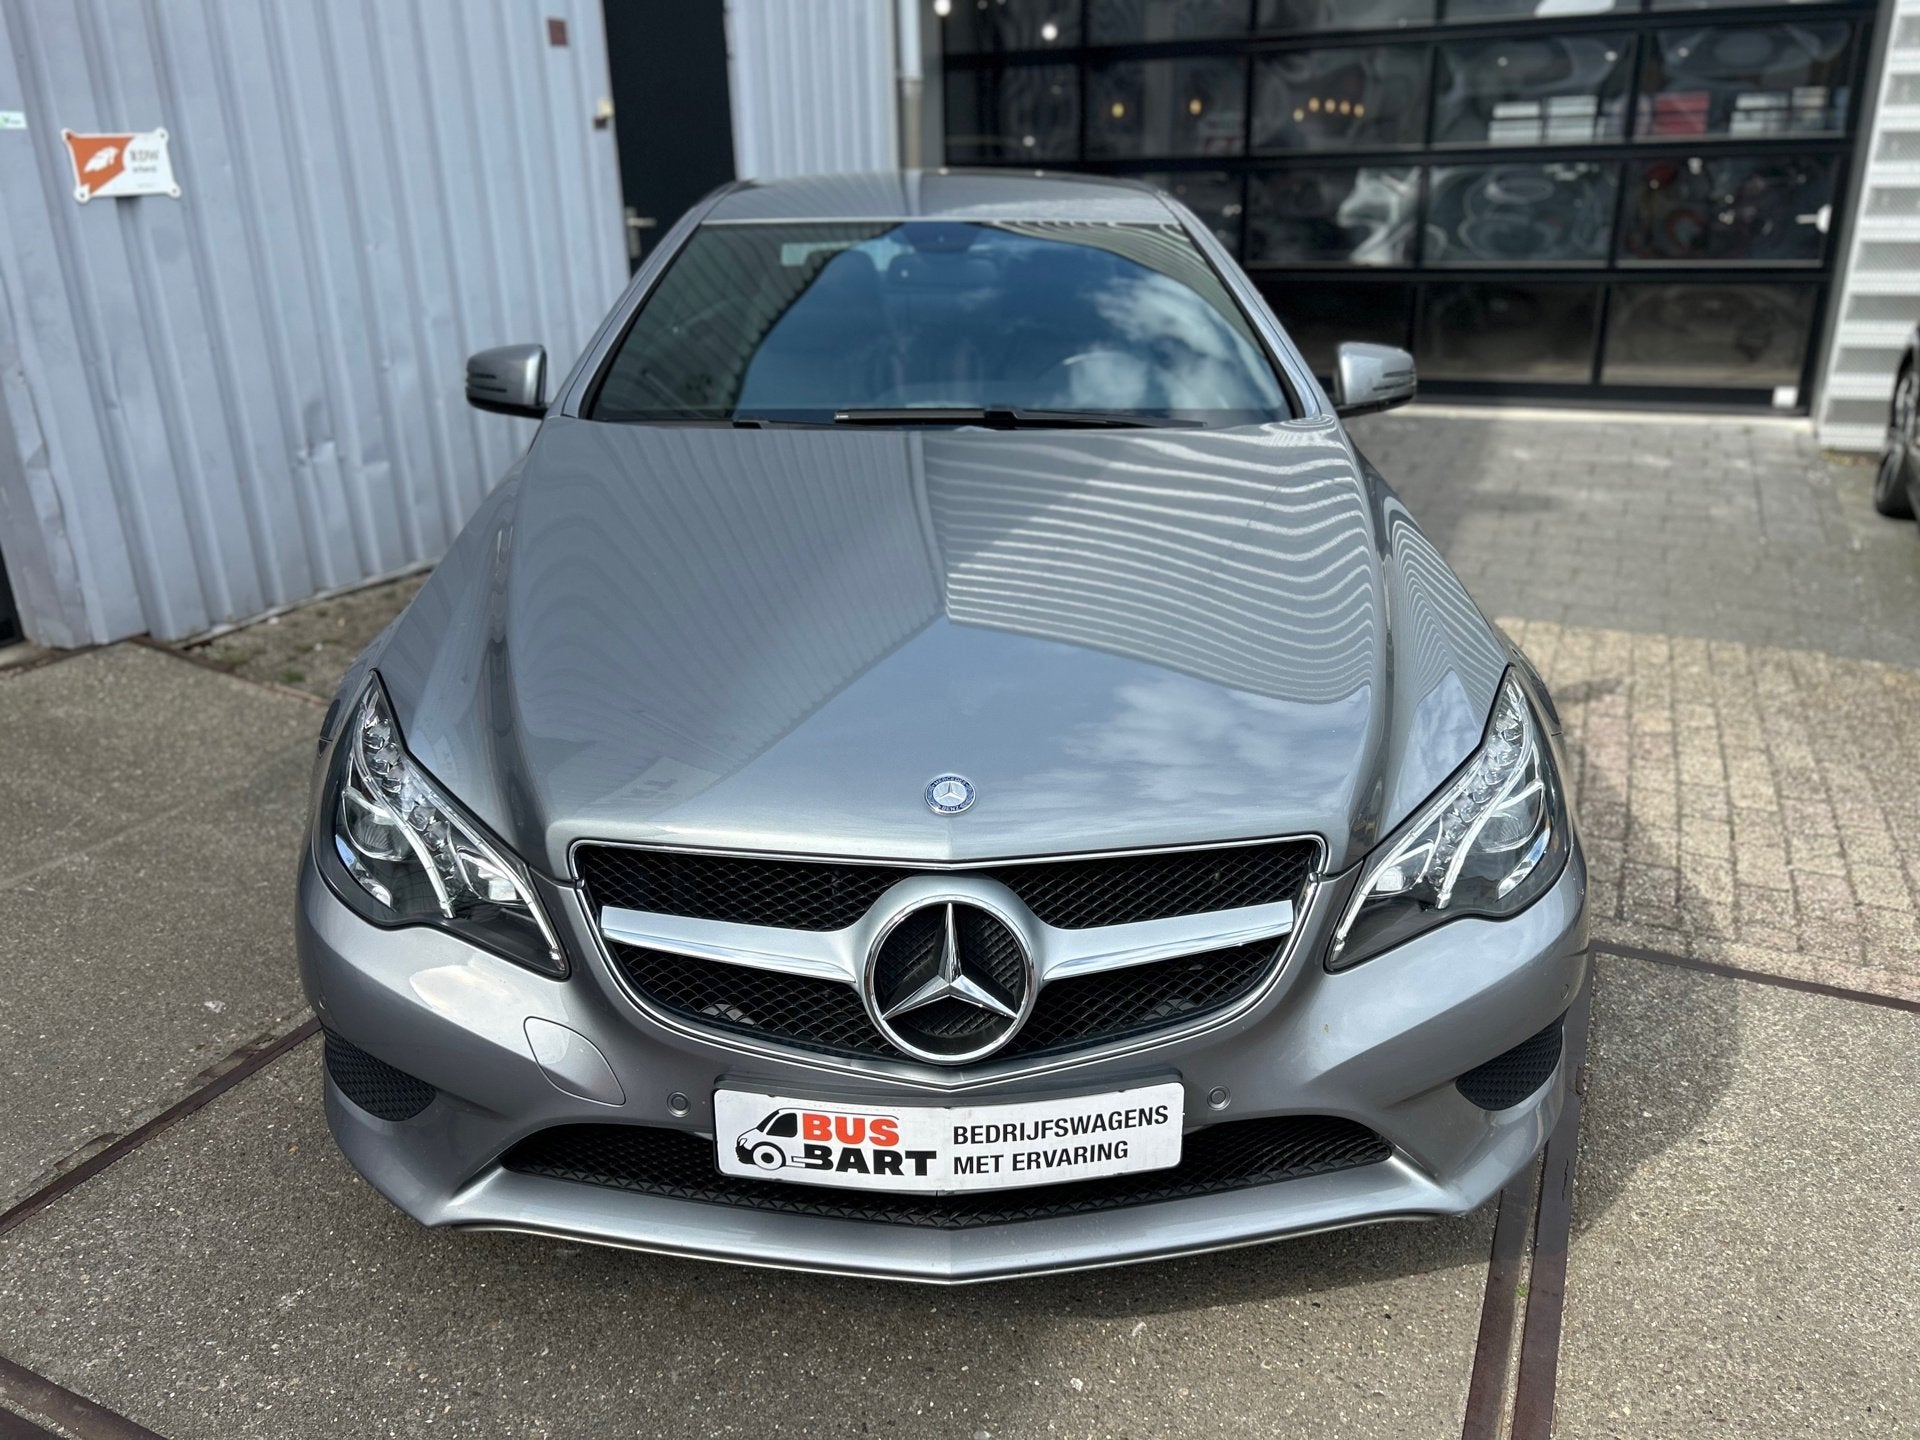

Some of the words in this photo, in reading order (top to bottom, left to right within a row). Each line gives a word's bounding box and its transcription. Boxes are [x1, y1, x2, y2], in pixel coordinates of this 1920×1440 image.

[802, 1113, 899, 1147] BUS
[954, 1105, 1169, 1146] BEDRIJFSWAGENS
[806, 1145, 937, 1177] BART
[954, 1154, 1004, 1176] MET
[1013, 1140, 1128, 1172] ERVARING
